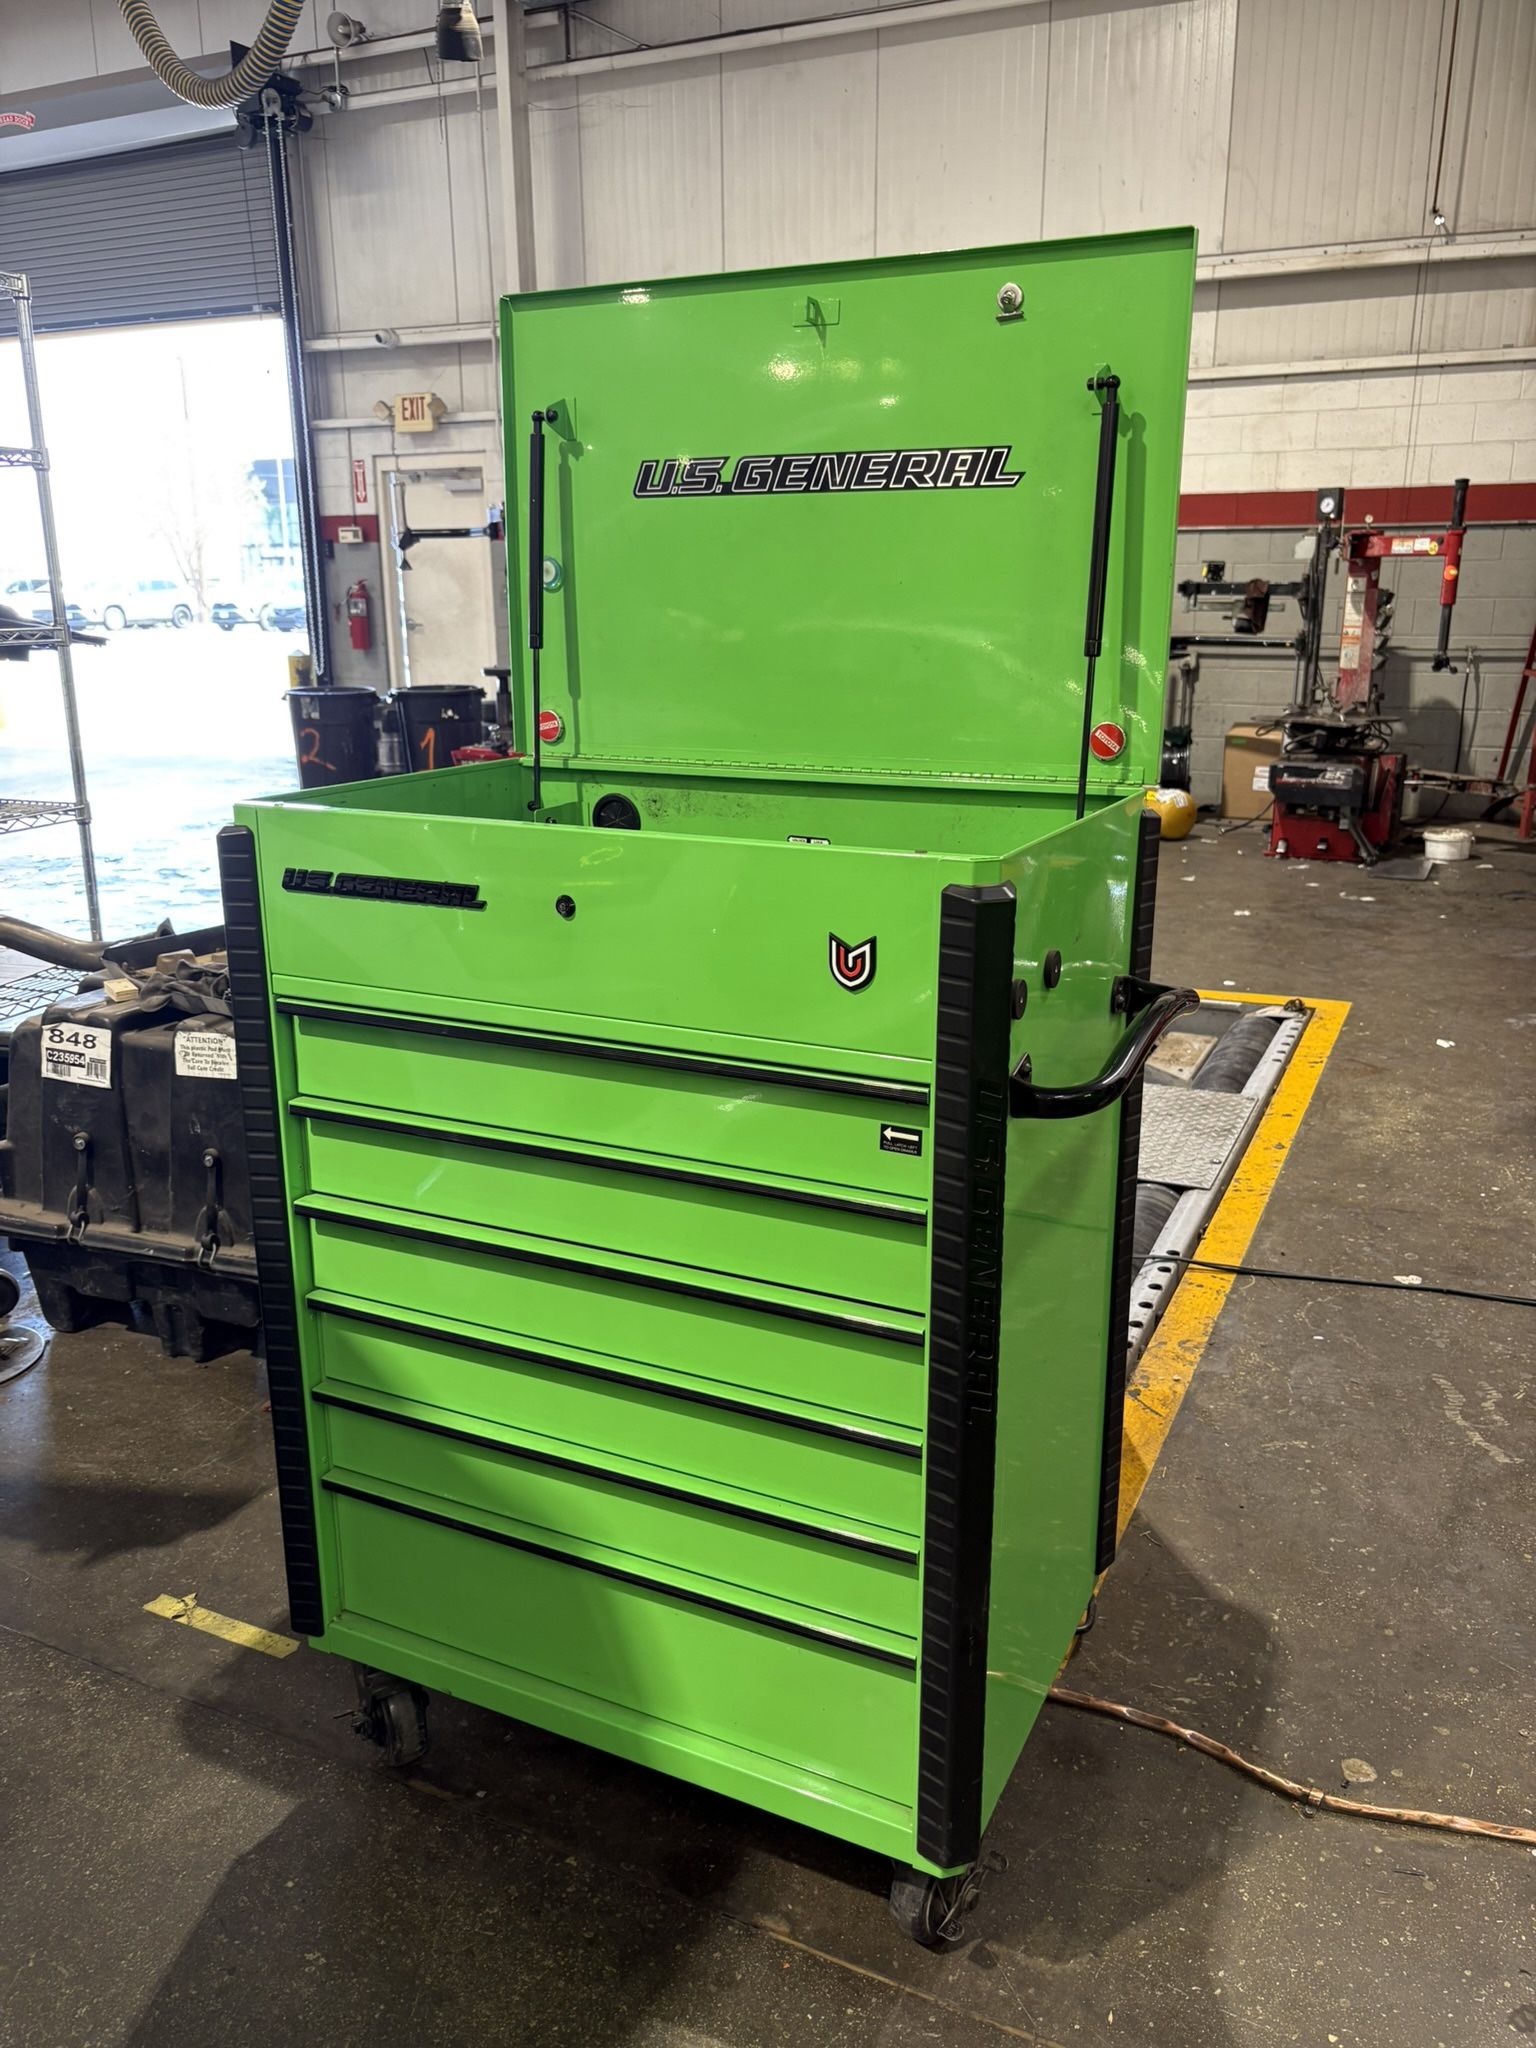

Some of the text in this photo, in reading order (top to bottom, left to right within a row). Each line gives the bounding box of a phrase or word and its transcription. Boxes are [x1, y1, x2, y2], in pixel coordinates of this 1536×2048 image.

[401, 396, 425, 421] EXIT
[730, 446, 1024, 494] GENERAL
[301, 727, 337, 771] 2
[419, 727, 435, 770] 1
[1097, 731, 1119, 751] TOYOTA
[49, 1028, 97, 1049] 848
[46, 1050, 85, 1066] C235954
